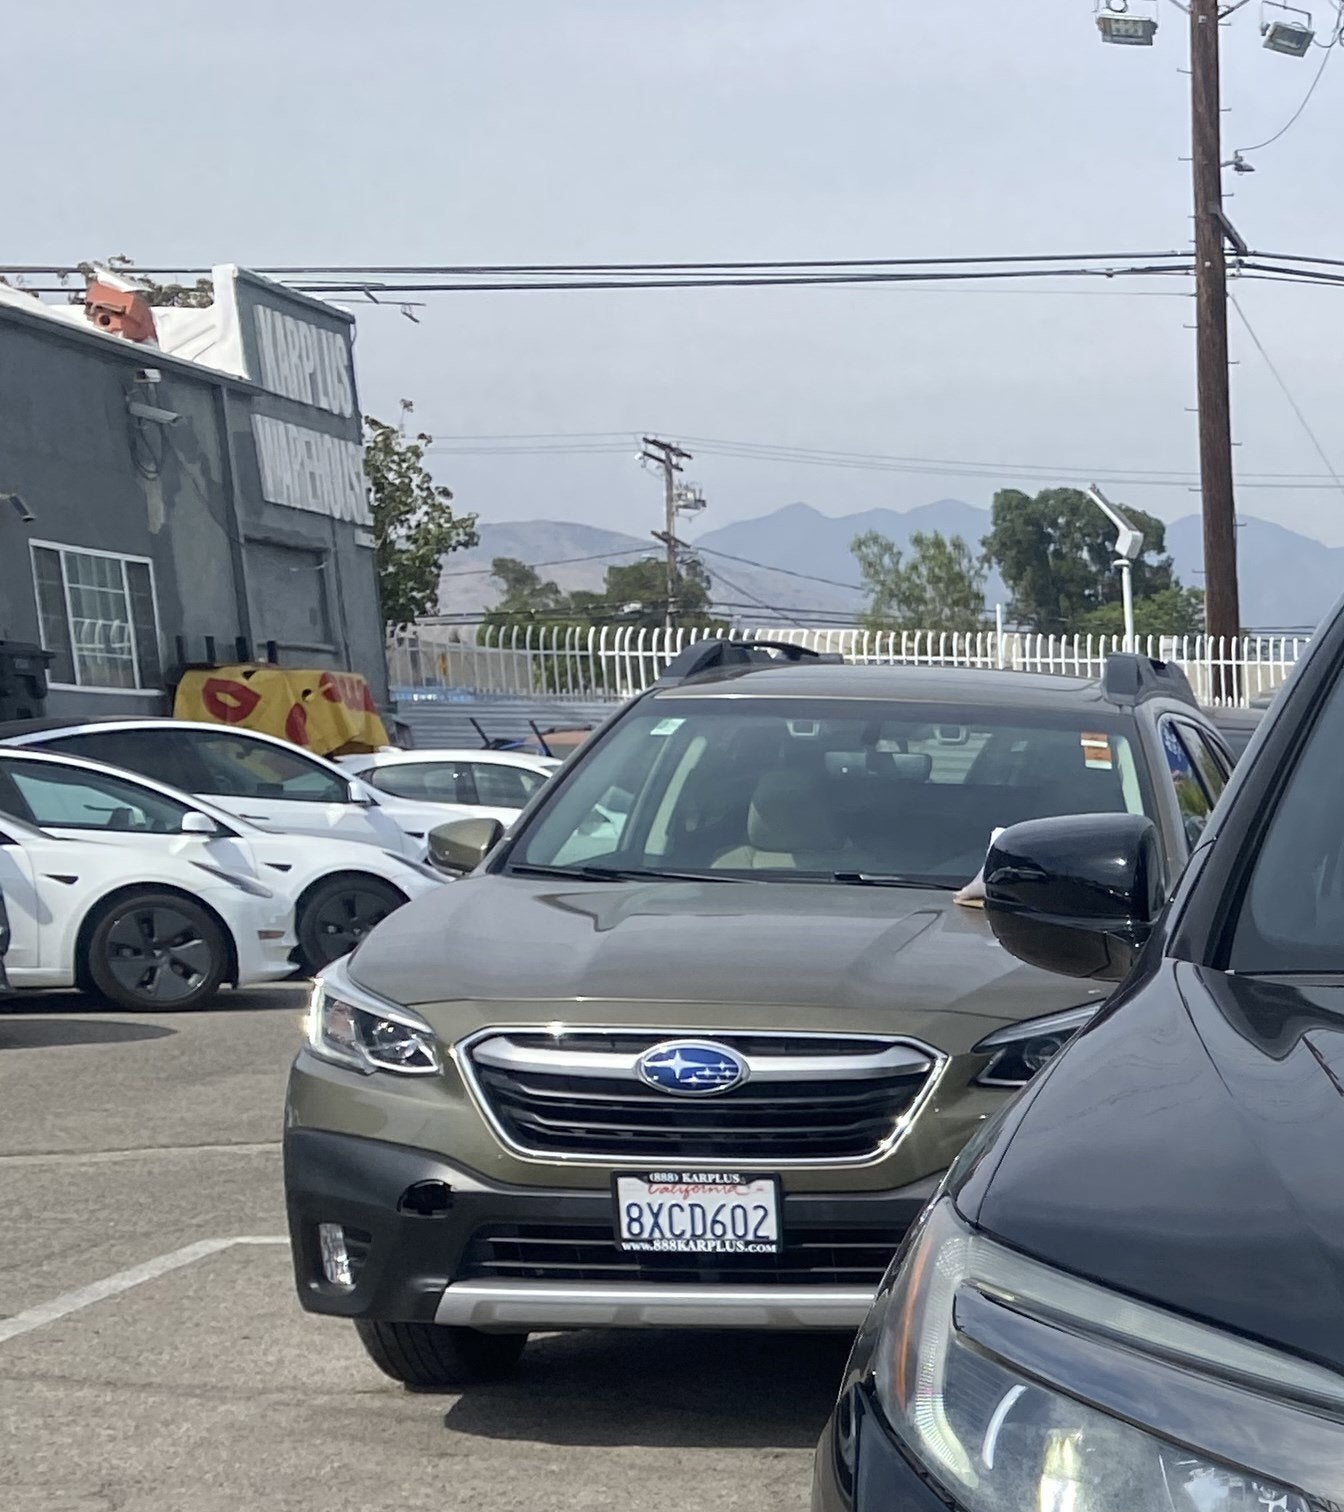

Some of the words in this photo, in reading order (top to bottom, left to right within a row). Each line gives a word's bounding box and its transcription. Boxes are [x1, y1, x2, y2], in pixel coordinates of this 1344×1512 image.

[253, 304, 353, 418] KARPLUS
[649, 1172, 679, 1183] (888)
[681, 1172, 740, 1184] KARPLUS
[647, 1184, 750, 1201] California
[625, 1202, 771, 1241] 8XCD602
